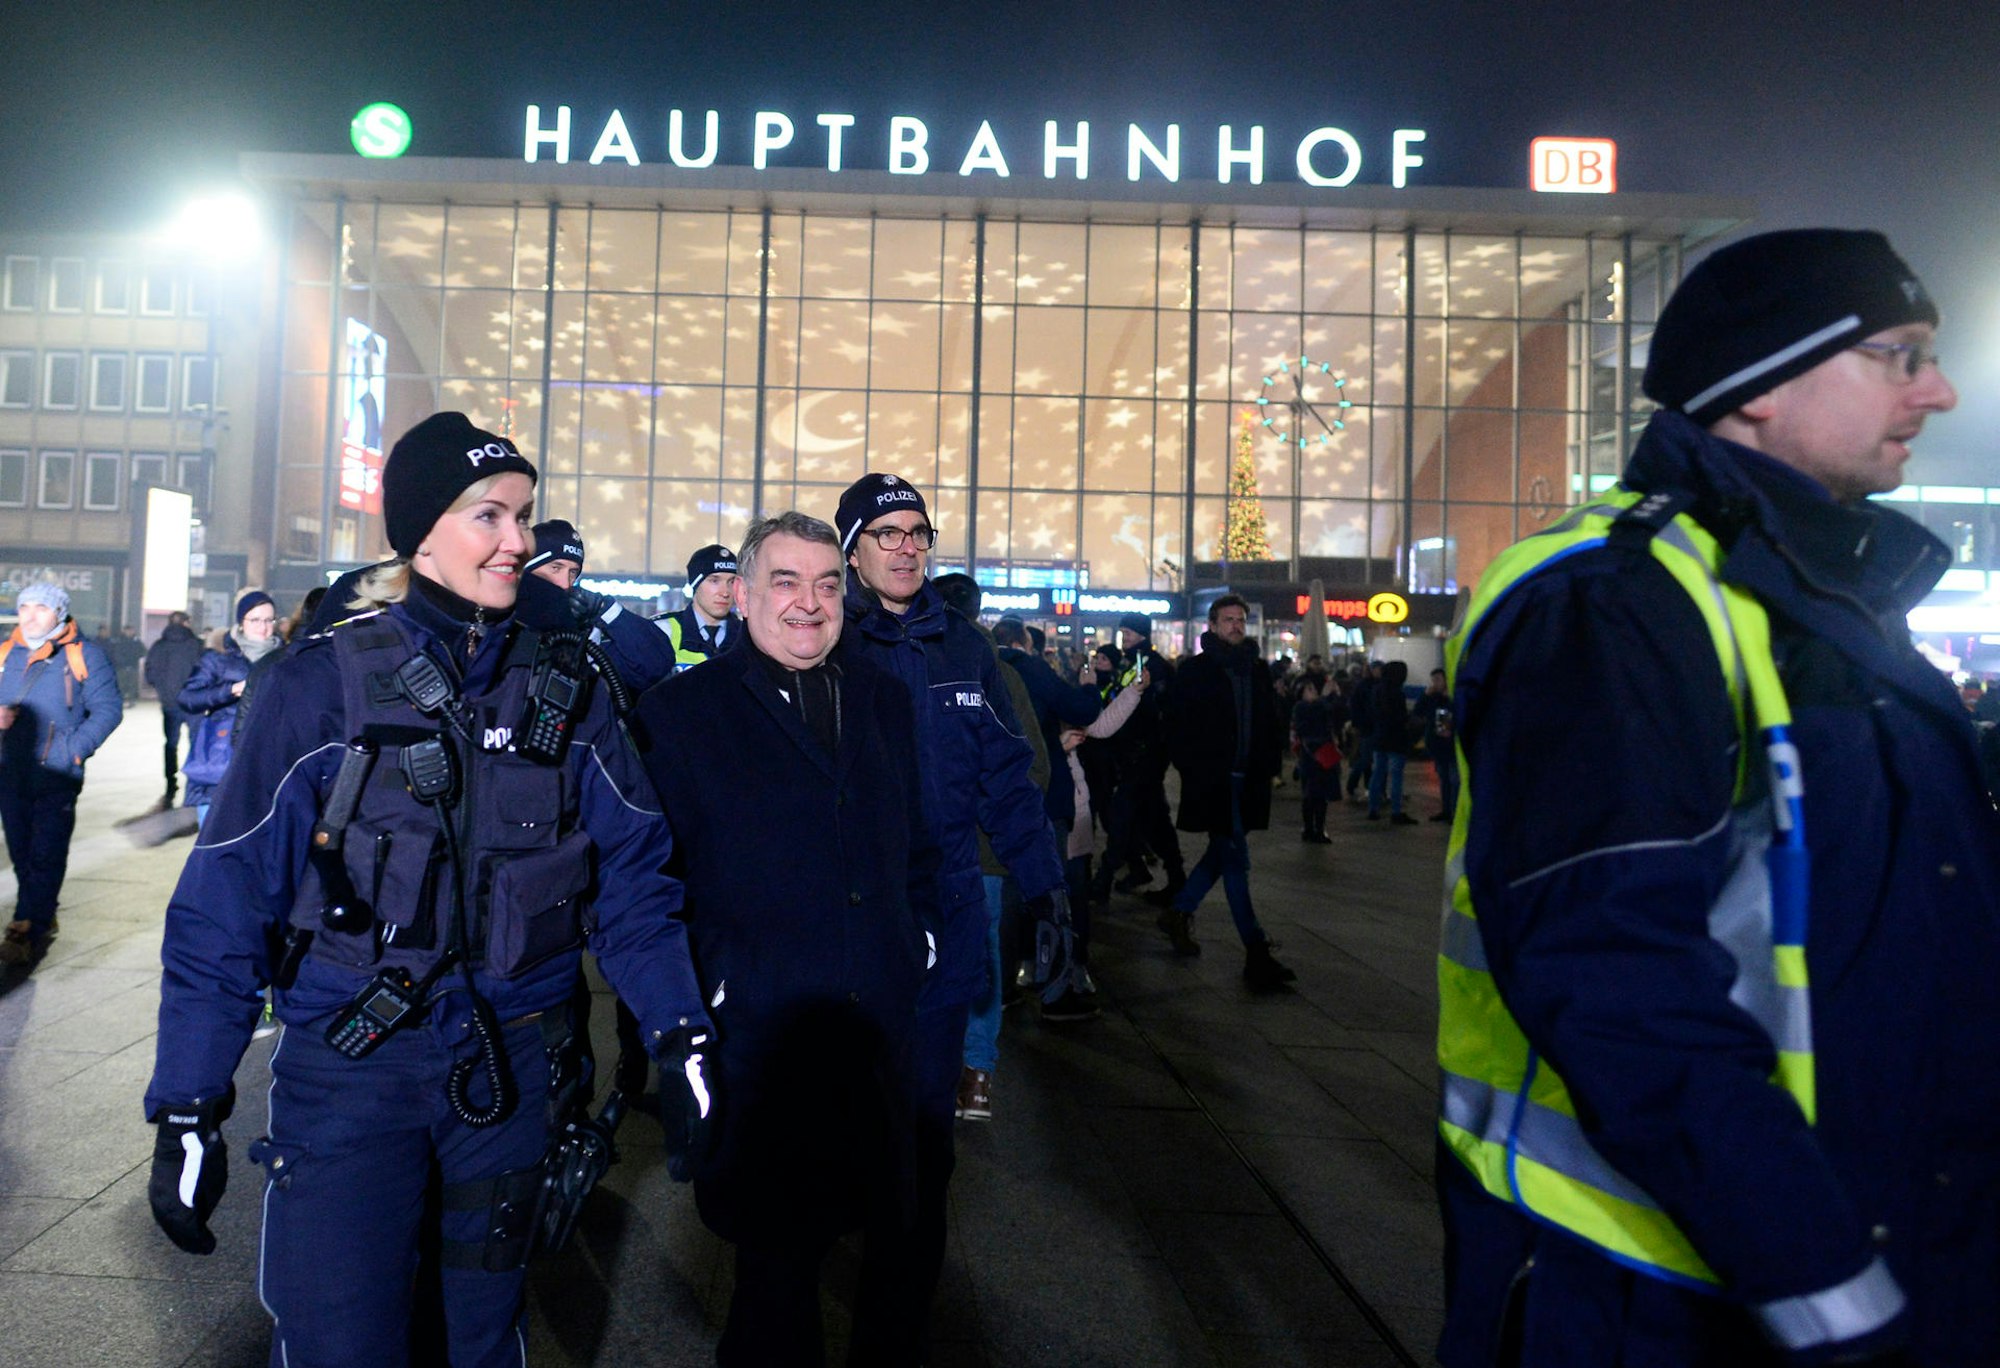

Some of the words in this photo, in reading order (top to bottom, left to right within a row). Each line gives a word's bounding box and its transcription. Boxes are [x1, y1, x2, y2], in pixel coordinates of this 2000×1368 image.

[361, 107, 402, 156] S
[523, 104, 1427, 189] HAUPTBAHNHOF
[1544, 149, 1603, 185] DB
[1296, 594, 1368, 621] Kmps
